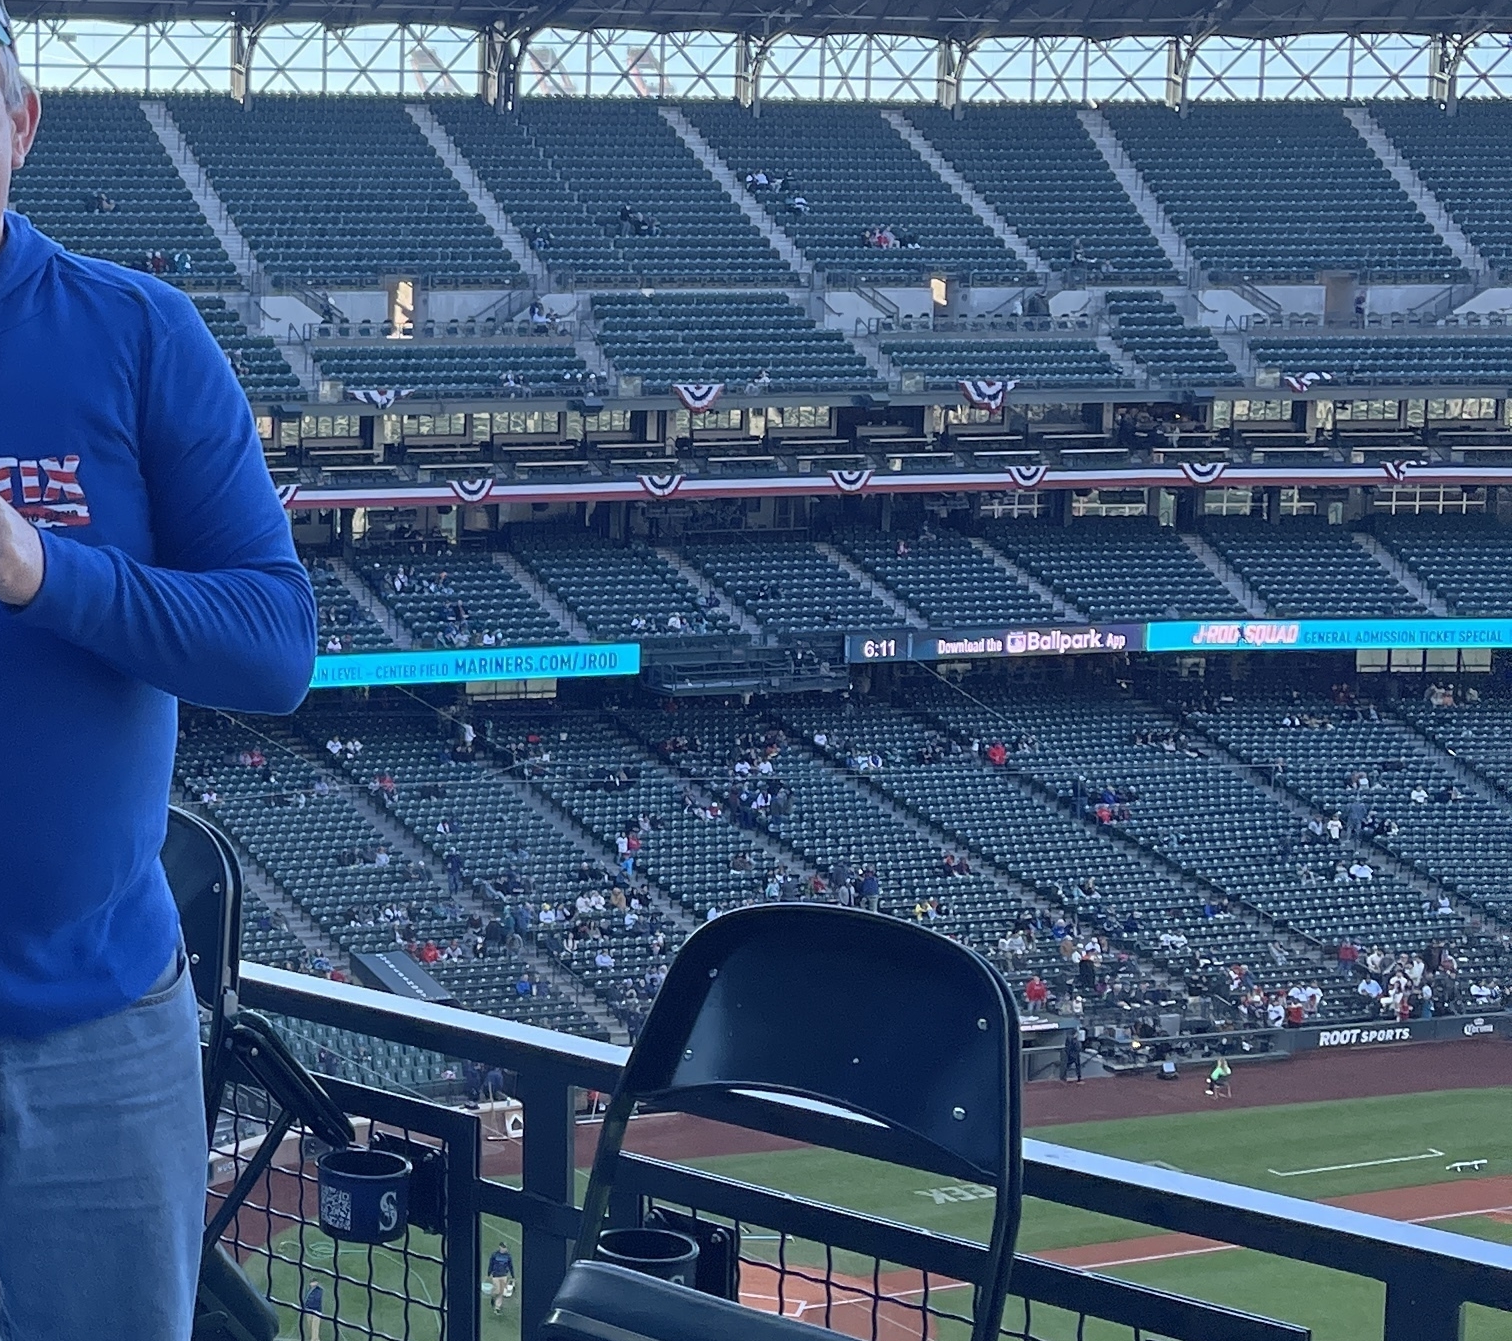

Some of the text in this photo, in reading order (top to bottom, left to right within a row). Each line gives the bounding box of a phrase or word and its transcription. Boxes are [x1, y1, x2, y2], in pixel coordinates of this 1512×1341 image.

[938, 629, 1126, 654] Download the Ballpark App
[1192, 623, 1240, 645] J-ROD
[1244, 622, 1300, 646] SQUAD
[1304, 631, 1352, 644] GENERAL
[1355, 630, 1416, 643] ADMISSION
[1419, 630, 1455, 643] TICKET
[1459, 630, 1503, 643] SPECIAL
[863, 639, 896, 658] 6:11
[331, 666, 363, 682] LEVEL
[375, 664, 417, 679] CENTER
[420, 663, 449, 677] FIELD
[454, 651, 618, 675] MARINERS.COM/JROD
[1319, 1027, 1410, 1046] ROOT SPORTS
[379, 1191, 398, 1231] S
